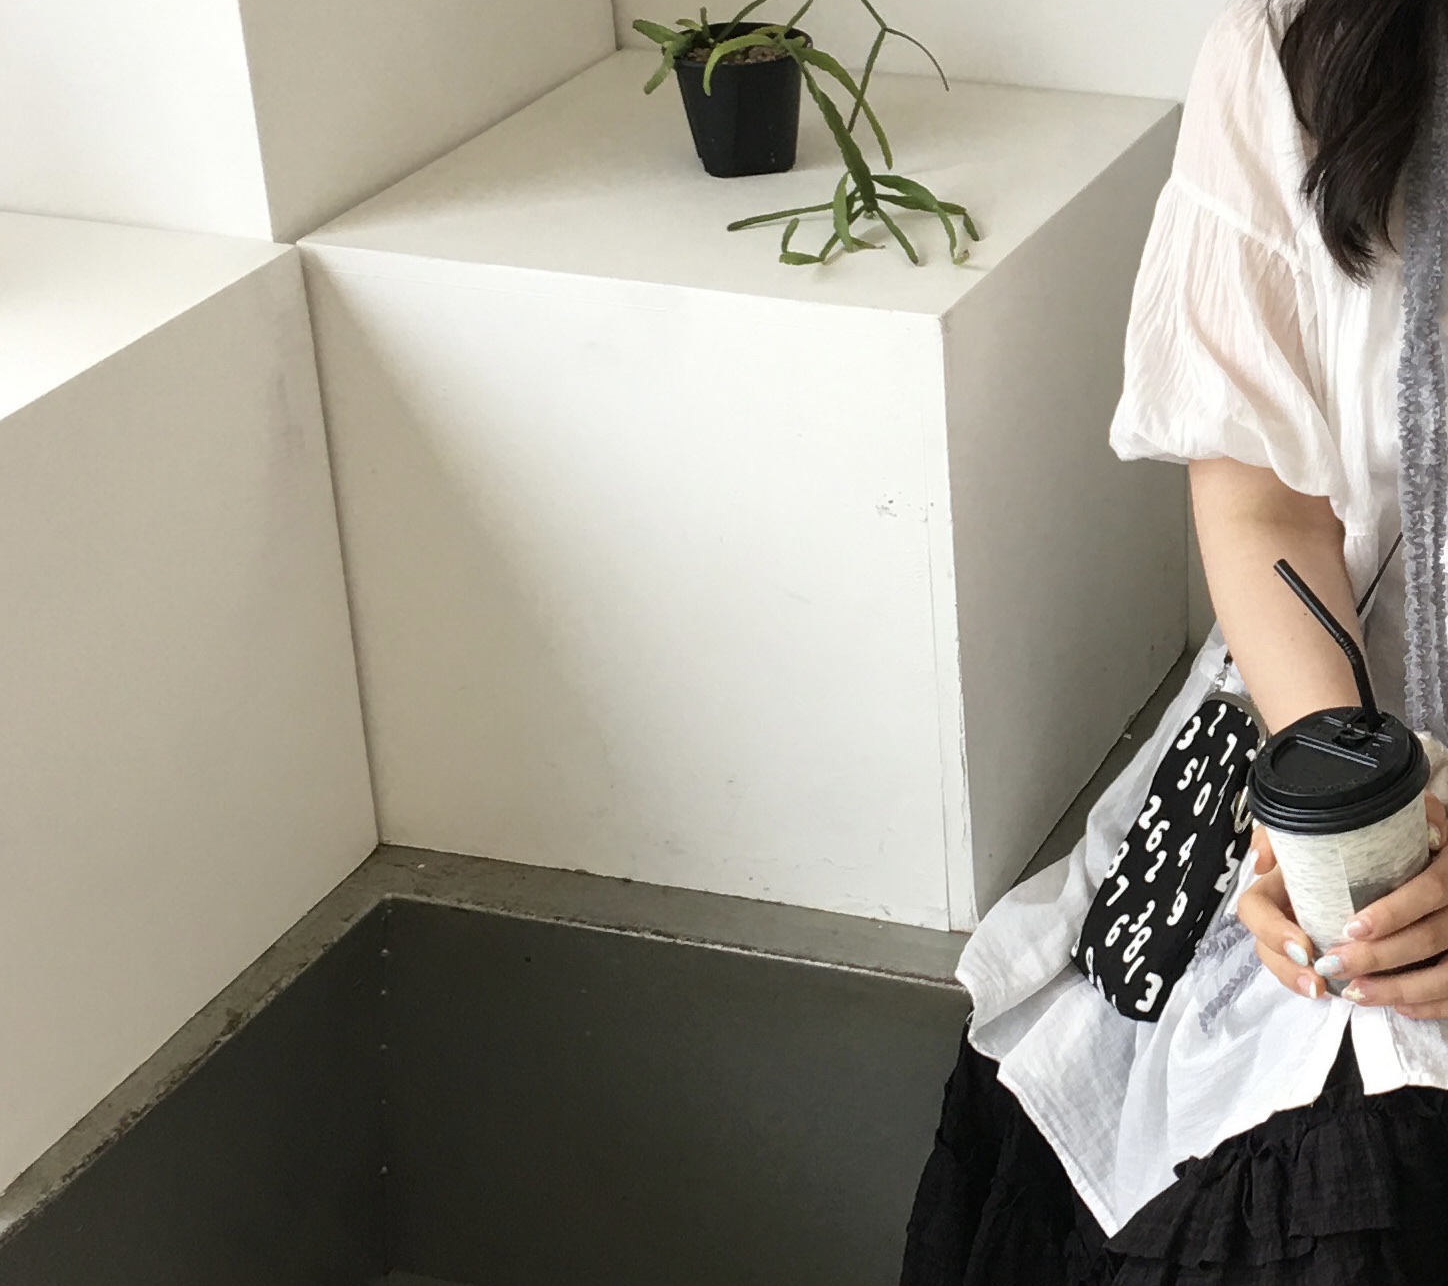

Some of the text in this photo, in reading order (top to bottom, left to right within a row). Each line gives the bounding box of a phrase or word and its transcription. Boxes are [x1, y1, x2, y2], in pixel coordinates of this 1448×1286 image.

[1177, 716, 1201, 750] 3
[1220, 733, 1237, 766] 7
[1177, 758, 1198, 790] 5
[1138, 795, 1161, 829] 2
[1193, 782, 1211, 816] 0
[1146, 820, 1170, 852] 6
[1178, 833, 1197, 867] 4
[1106, 841, 1129, 879] 8
[1145, 850, 1167, 882] 2
[1106, 875, 1129, 906] 7
[1129, 900, 1155, 933] 3
[1167, 891, 1188, 926] 9
[1105, 914, 1130, 947] 6
[1123, 927, 1152, 963] 8
[1135, 972, 1163, 1012] 3
